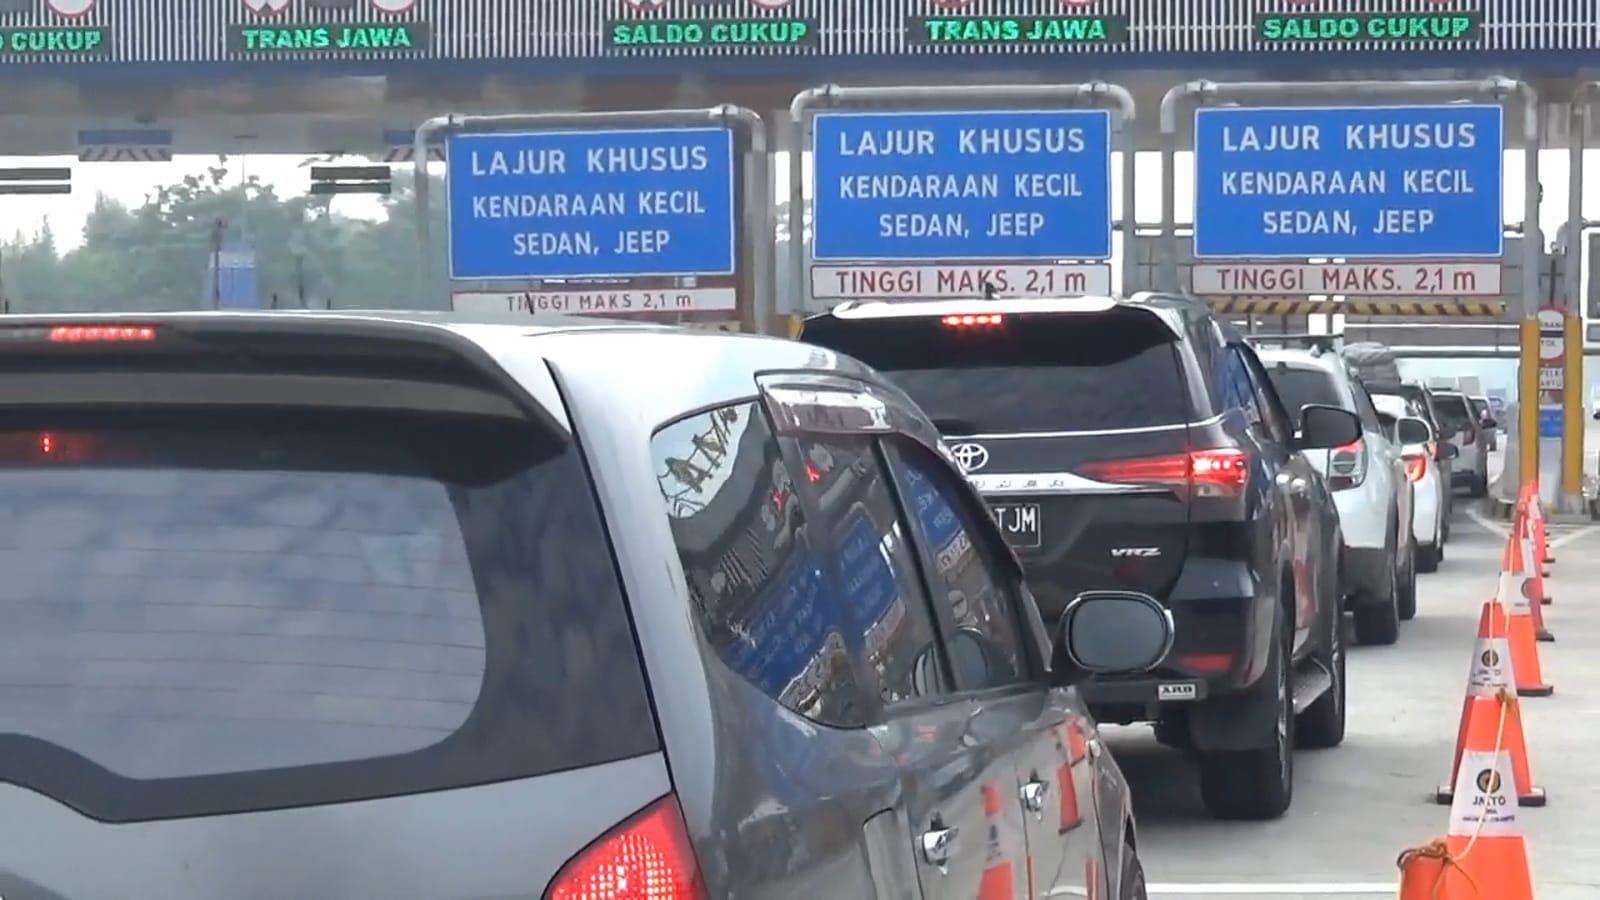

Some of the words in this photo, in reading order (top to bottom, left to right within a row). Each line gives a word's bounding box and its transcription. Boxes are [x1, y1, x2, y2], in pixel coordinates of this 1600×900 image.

[11, 31, 101, 51] CUKUP
[242, 28, 330, 49] TRANS
[336, 28, 411, 48] JAWA
[613, 24, 703, 44] SALDO
[711, 22, 807, 43] CUKUP
[926, 19, 1019, 40] TRANS
[1026, 19, 1107, 40] JAWA
[1264, 18, 1359, 39] SALDO
[1367, 17, 1470, 38] CUKUP
[839, 130, 935, 156] LAJUR
[959, 128, 1085, 154] KHUSUS
[1222, 125, 1321, 151] LAJUR
[1346, 123, 1476, 150] KHUSUS
[471, 150, 566, 176] LAJUR
[587, 146, 709, 173] KHUSUS
[839, 174, 998, 198] KENDARAAN
[1014, 173, 1083, 197] KECIL
[1222, 170, 1386, 195] KENDARAAN
[1403, 169, 1474, 193] KECIL
[472, 193, 625, 218] KENDARAAN
[639, 191, 705, 215] KECIL
[879, 213, 970, 238] SEDAN,
[986, 212, 1044, 237] JEEP
[1262, 209, 1357, 236] SEDAN,
[1373, 209, 1435, 234] JEEP
[513, 232, 600, 257] SEDAN,
[614, 230, 670, 254] JEEP
[835, 271, 922, 293] TINGGI
[937, 270, 1015, 293] MAKS.
[1025, 269, 1055, 295] 2,1
[1065, 272, 1086, 292] m
[1217, 268, 1304, 290] TINGGI
[1322, 267, 1401, 290] MAKS.
[1415, 268, 1443, 293] 2,1
[1453, 269, 1476, 290] m
[506, 295, 569, 312] TINGGI
[579, 294, 632, 310] MAKS
[643, 293, 666, 309] 2,1
[676, 294, 691, 307] m
